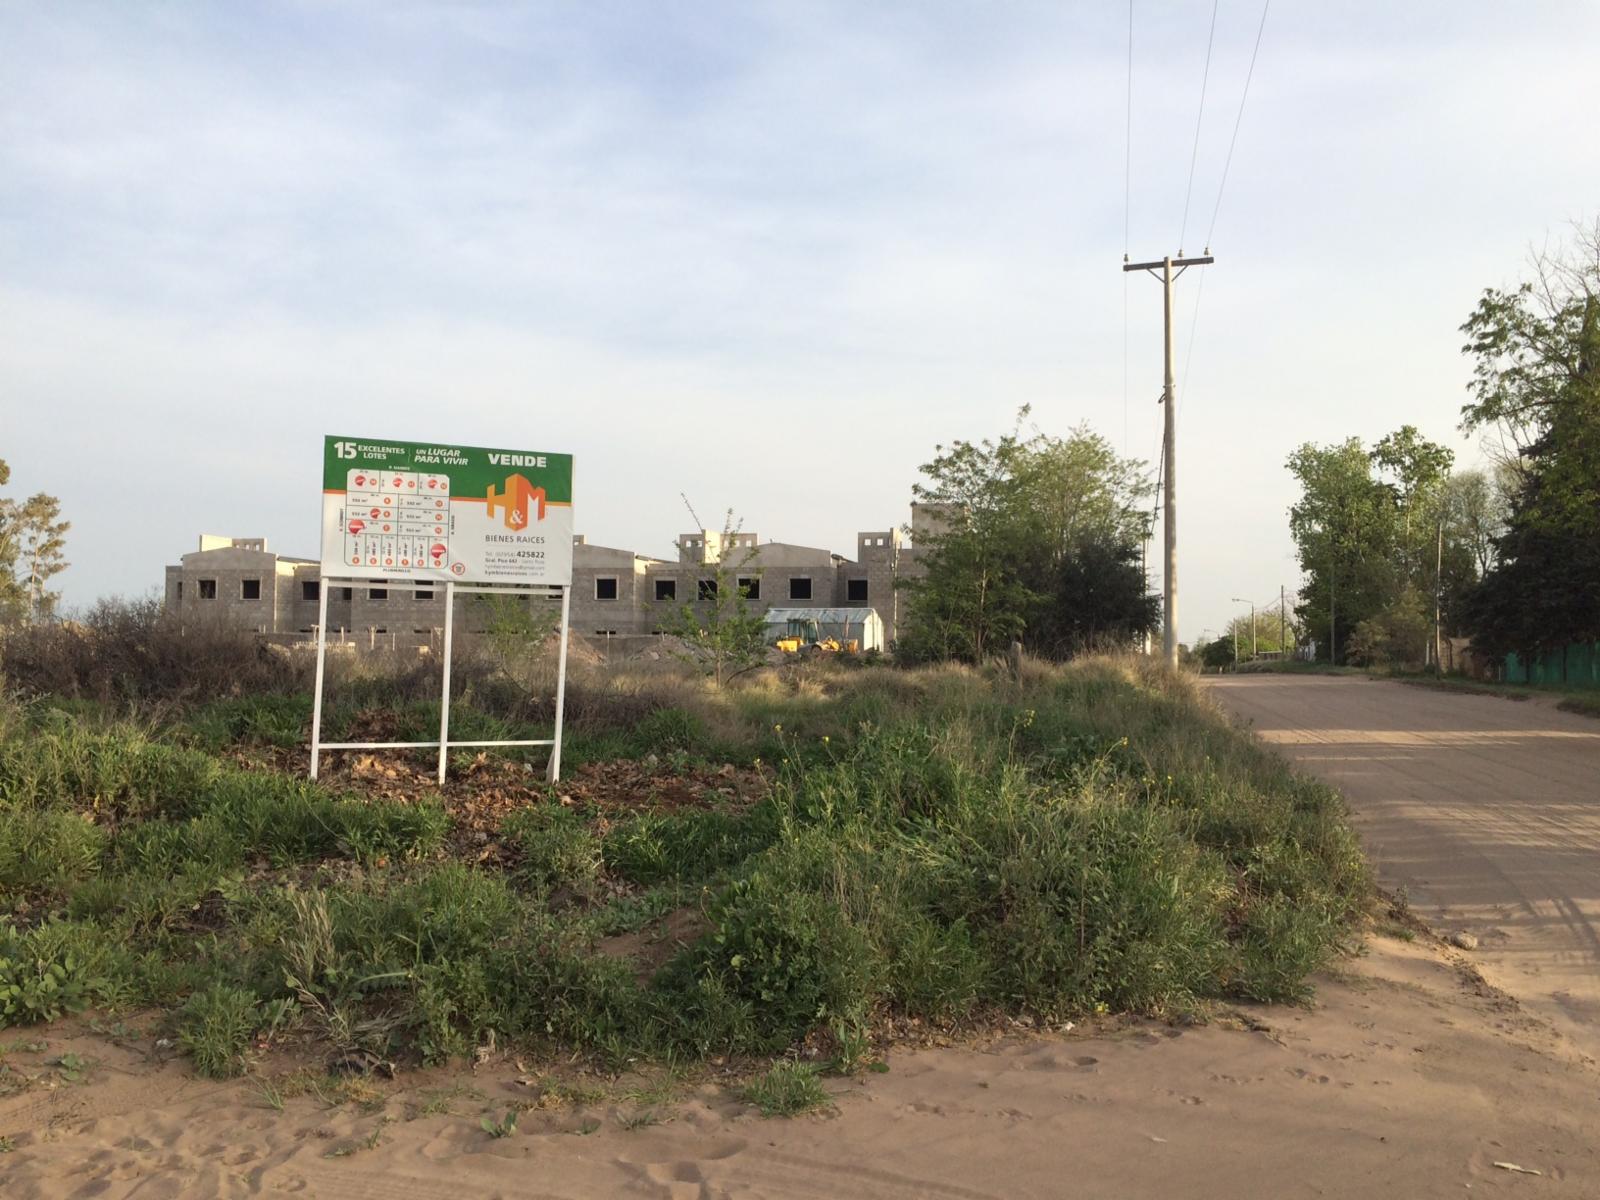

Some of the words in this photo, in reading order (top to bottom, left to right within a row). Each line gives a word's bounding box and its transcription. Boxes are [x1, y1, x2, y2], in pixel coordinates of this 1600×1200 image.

[334, 441, 357, 459] 15
[358, 445, 406, 455] EXCELENTES
[427, 448, 461, 457] LUGAR
[363, 452, 387, 460] LOTES
[414, 455, 440, 464] PARA
[443, 457, 469, 465] VIVIR
[487, 453, 547, 468] VENDE
[485, 535, 514, 543] BIENES
[516, 535, 545, 544] RAICES
[516, 550, 545, 558] 425822
